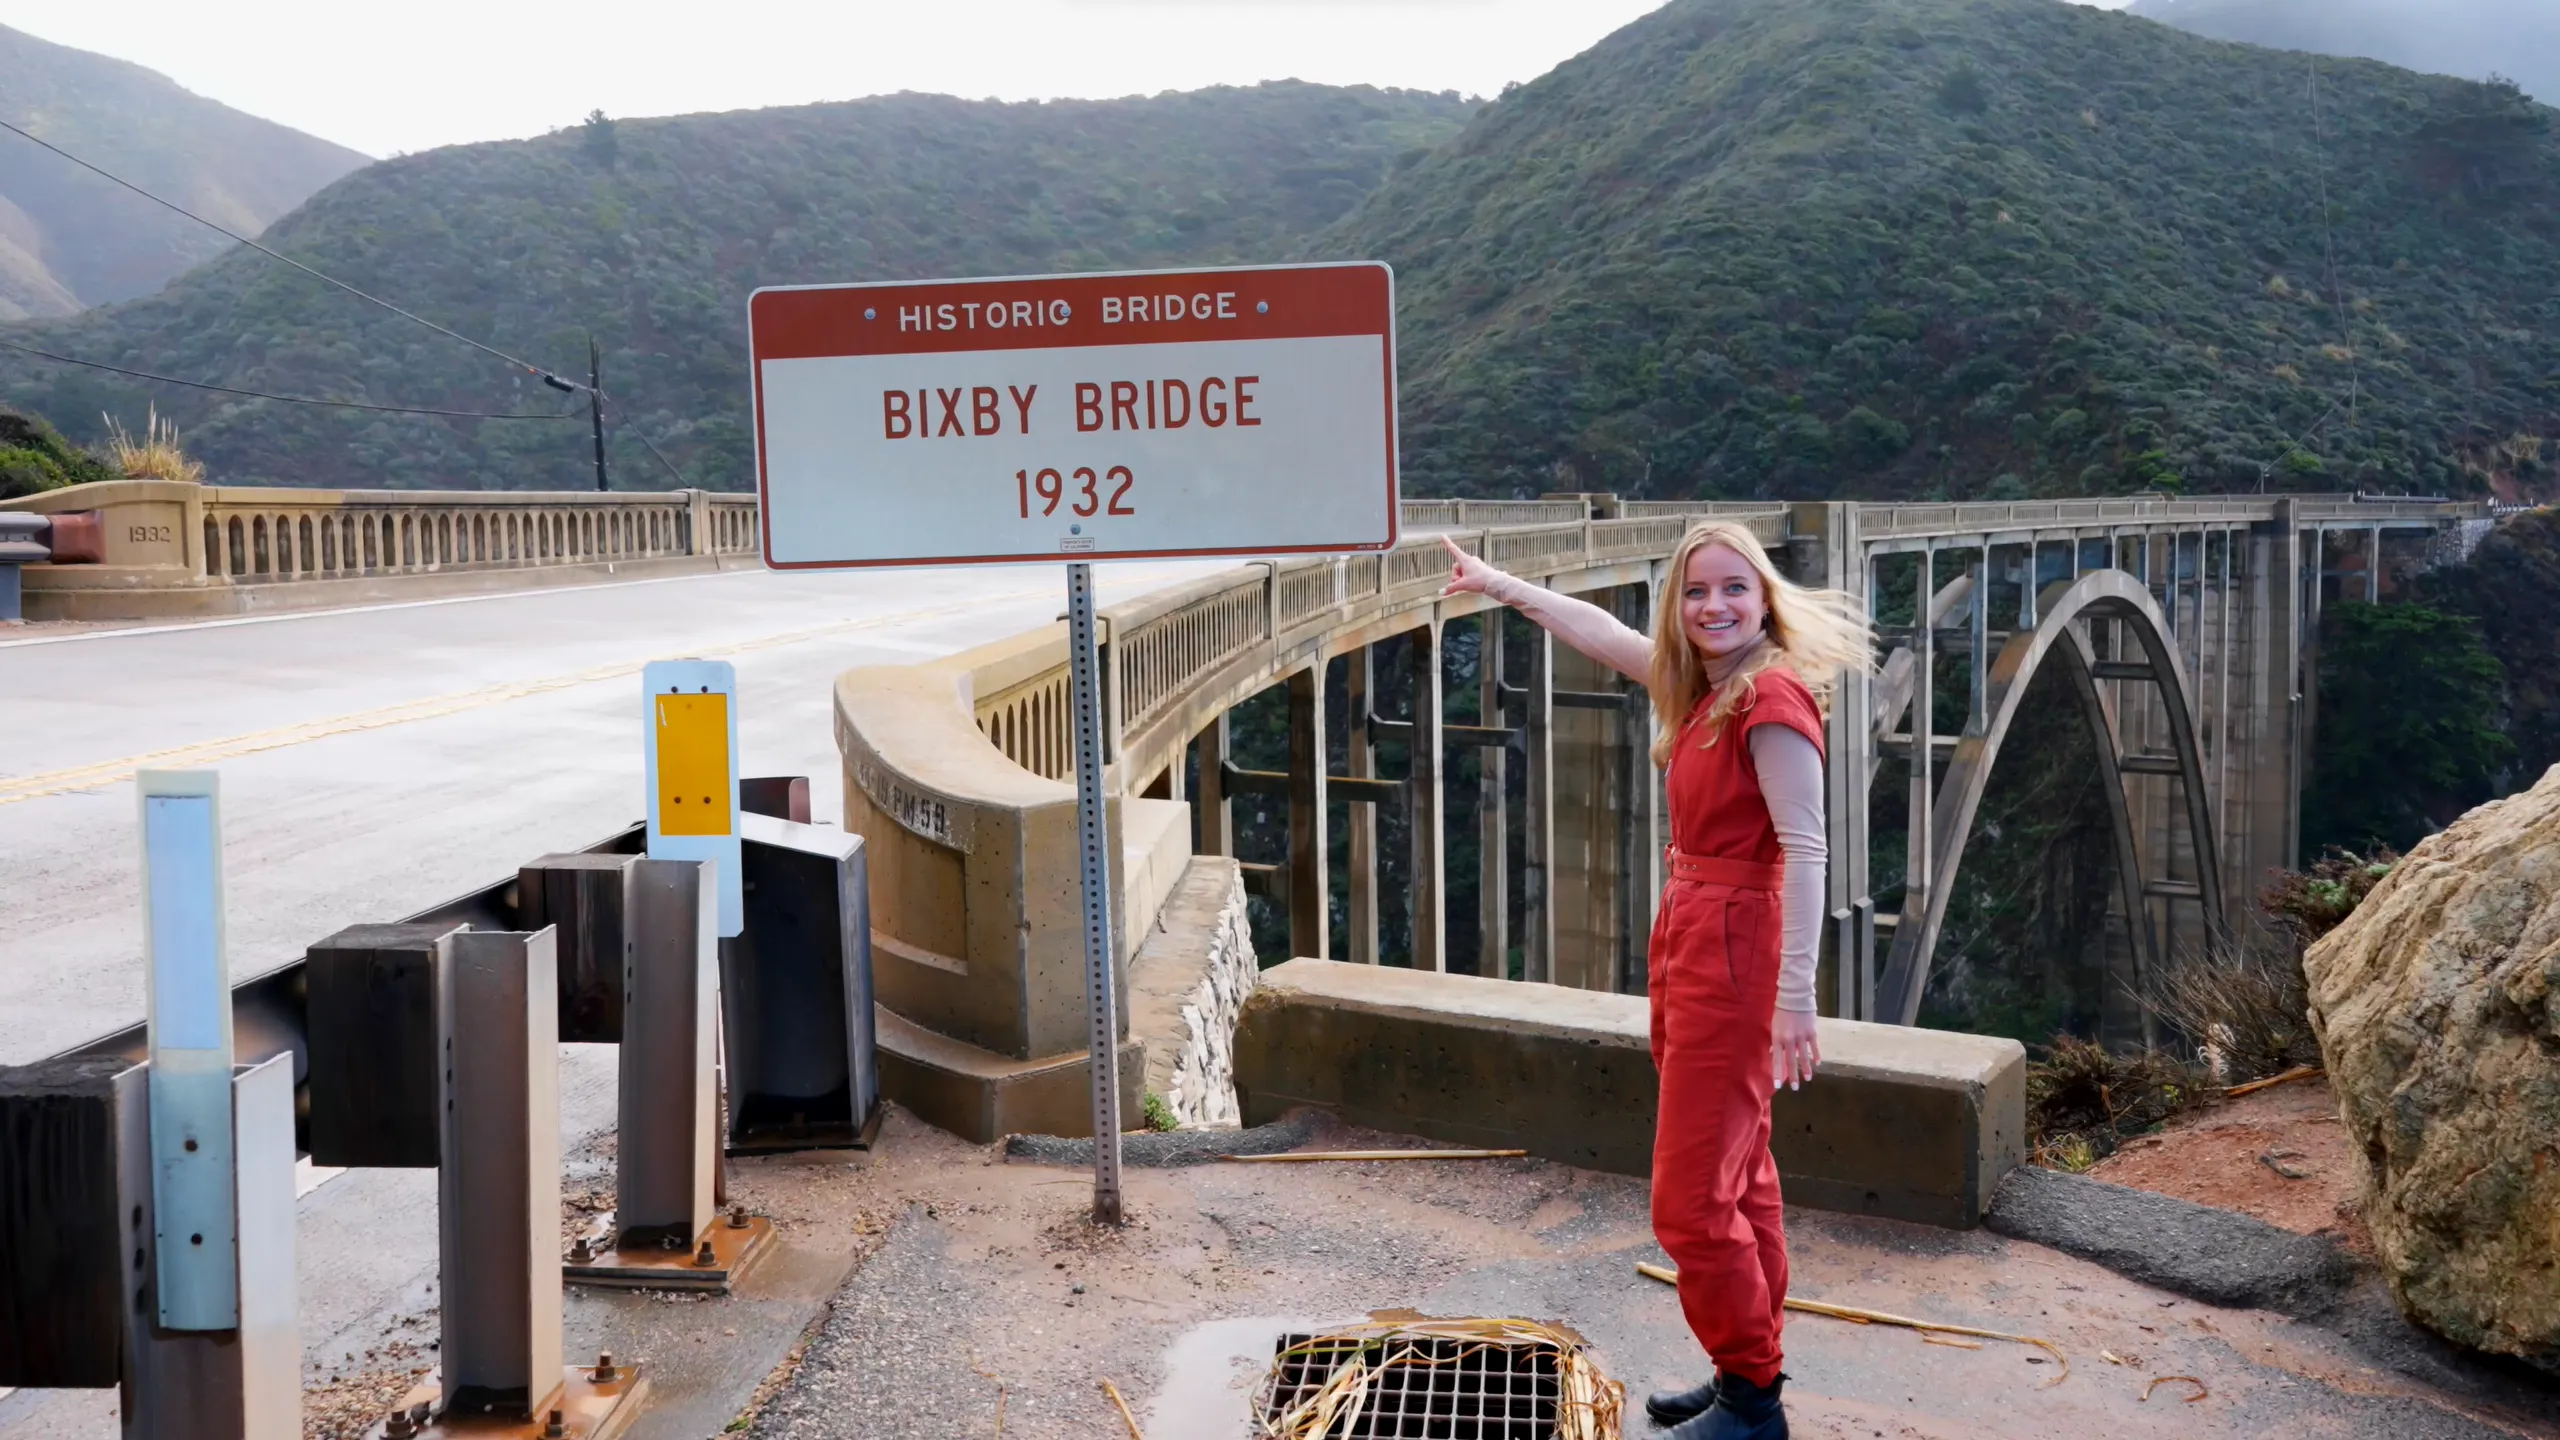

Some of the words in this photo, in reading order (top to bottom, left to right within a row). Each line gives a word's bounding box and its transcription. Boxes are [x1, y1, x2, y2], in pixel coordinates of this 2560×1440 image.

[900, 299, 1071, 331] HISTORIC
[1102, 292, 1237, 323] BRIDGE
[883, 384, 1037, 440] BIXBY
[1075, 376, 1262, 433] BRIDGE
[1016, 465, 1135, 519] 1932
[129, 526, 172, 544] 1932
